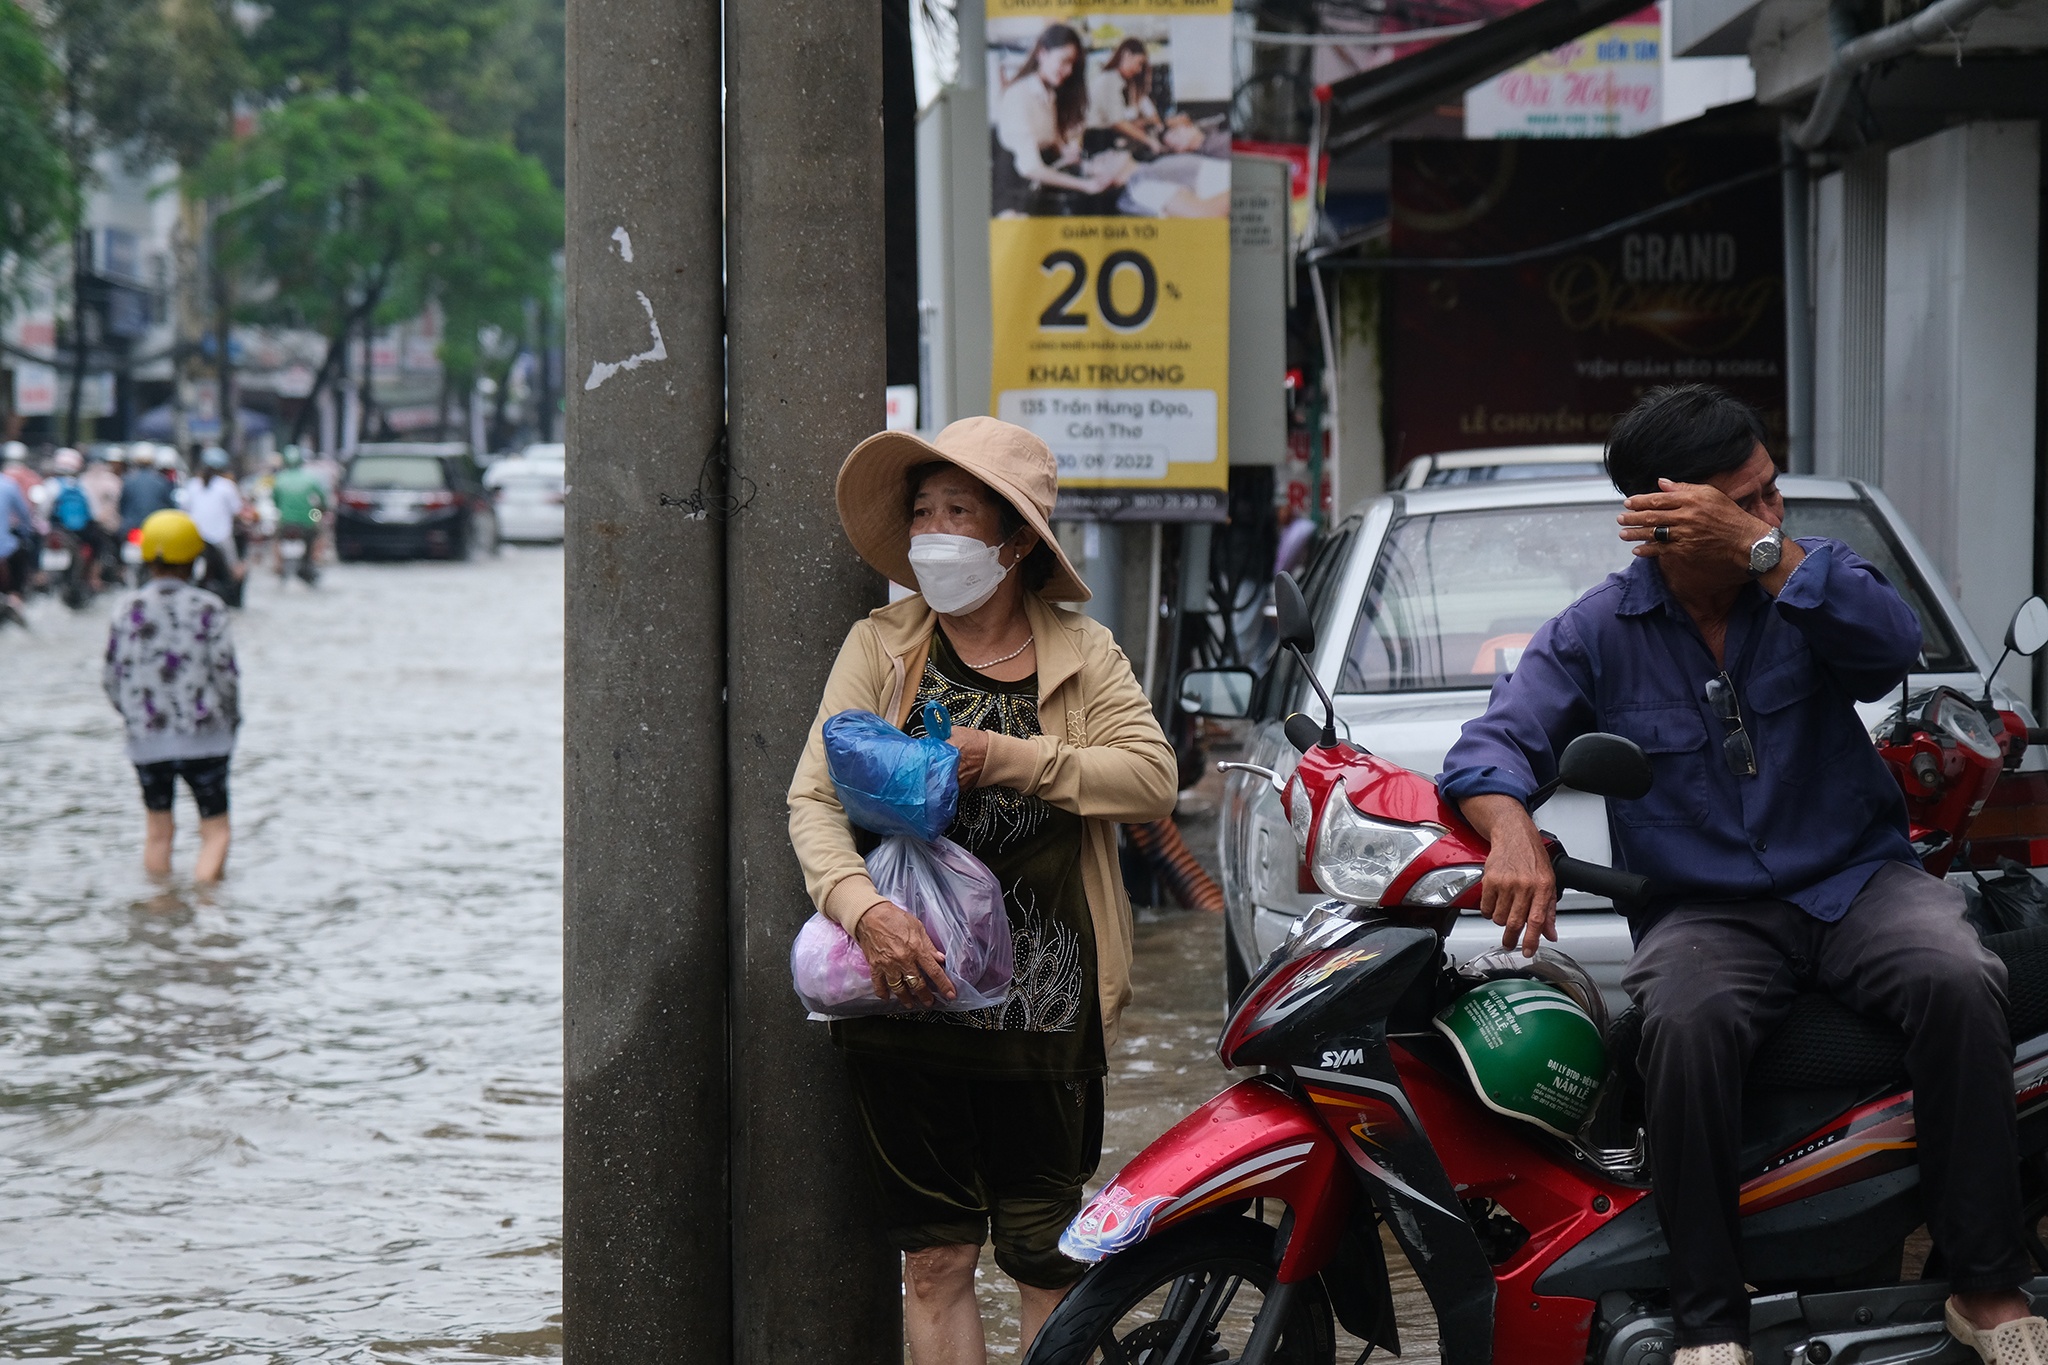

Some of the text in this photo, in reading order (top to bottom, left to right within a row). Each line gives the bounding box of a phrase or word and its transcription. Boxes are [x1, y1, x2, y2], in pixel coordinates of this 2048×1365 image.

[1622, 232, 1737, 281] GRAND
[1029, 366, 1080, 383] KHAI
[1320, 1049, 1365, 1069] SYM
[1547, 1059, 1560, 1071] ĐẠI
[1557, 1064, 1568, 1074] LÝ
[1552, 1076, 1579, 1096] NĂM
[1576, 1087, 1590, 1102] LỆ
[1778, 1135, 1835, 1165] STROKE
[1640, 1341, 1665, 1352] SYM
